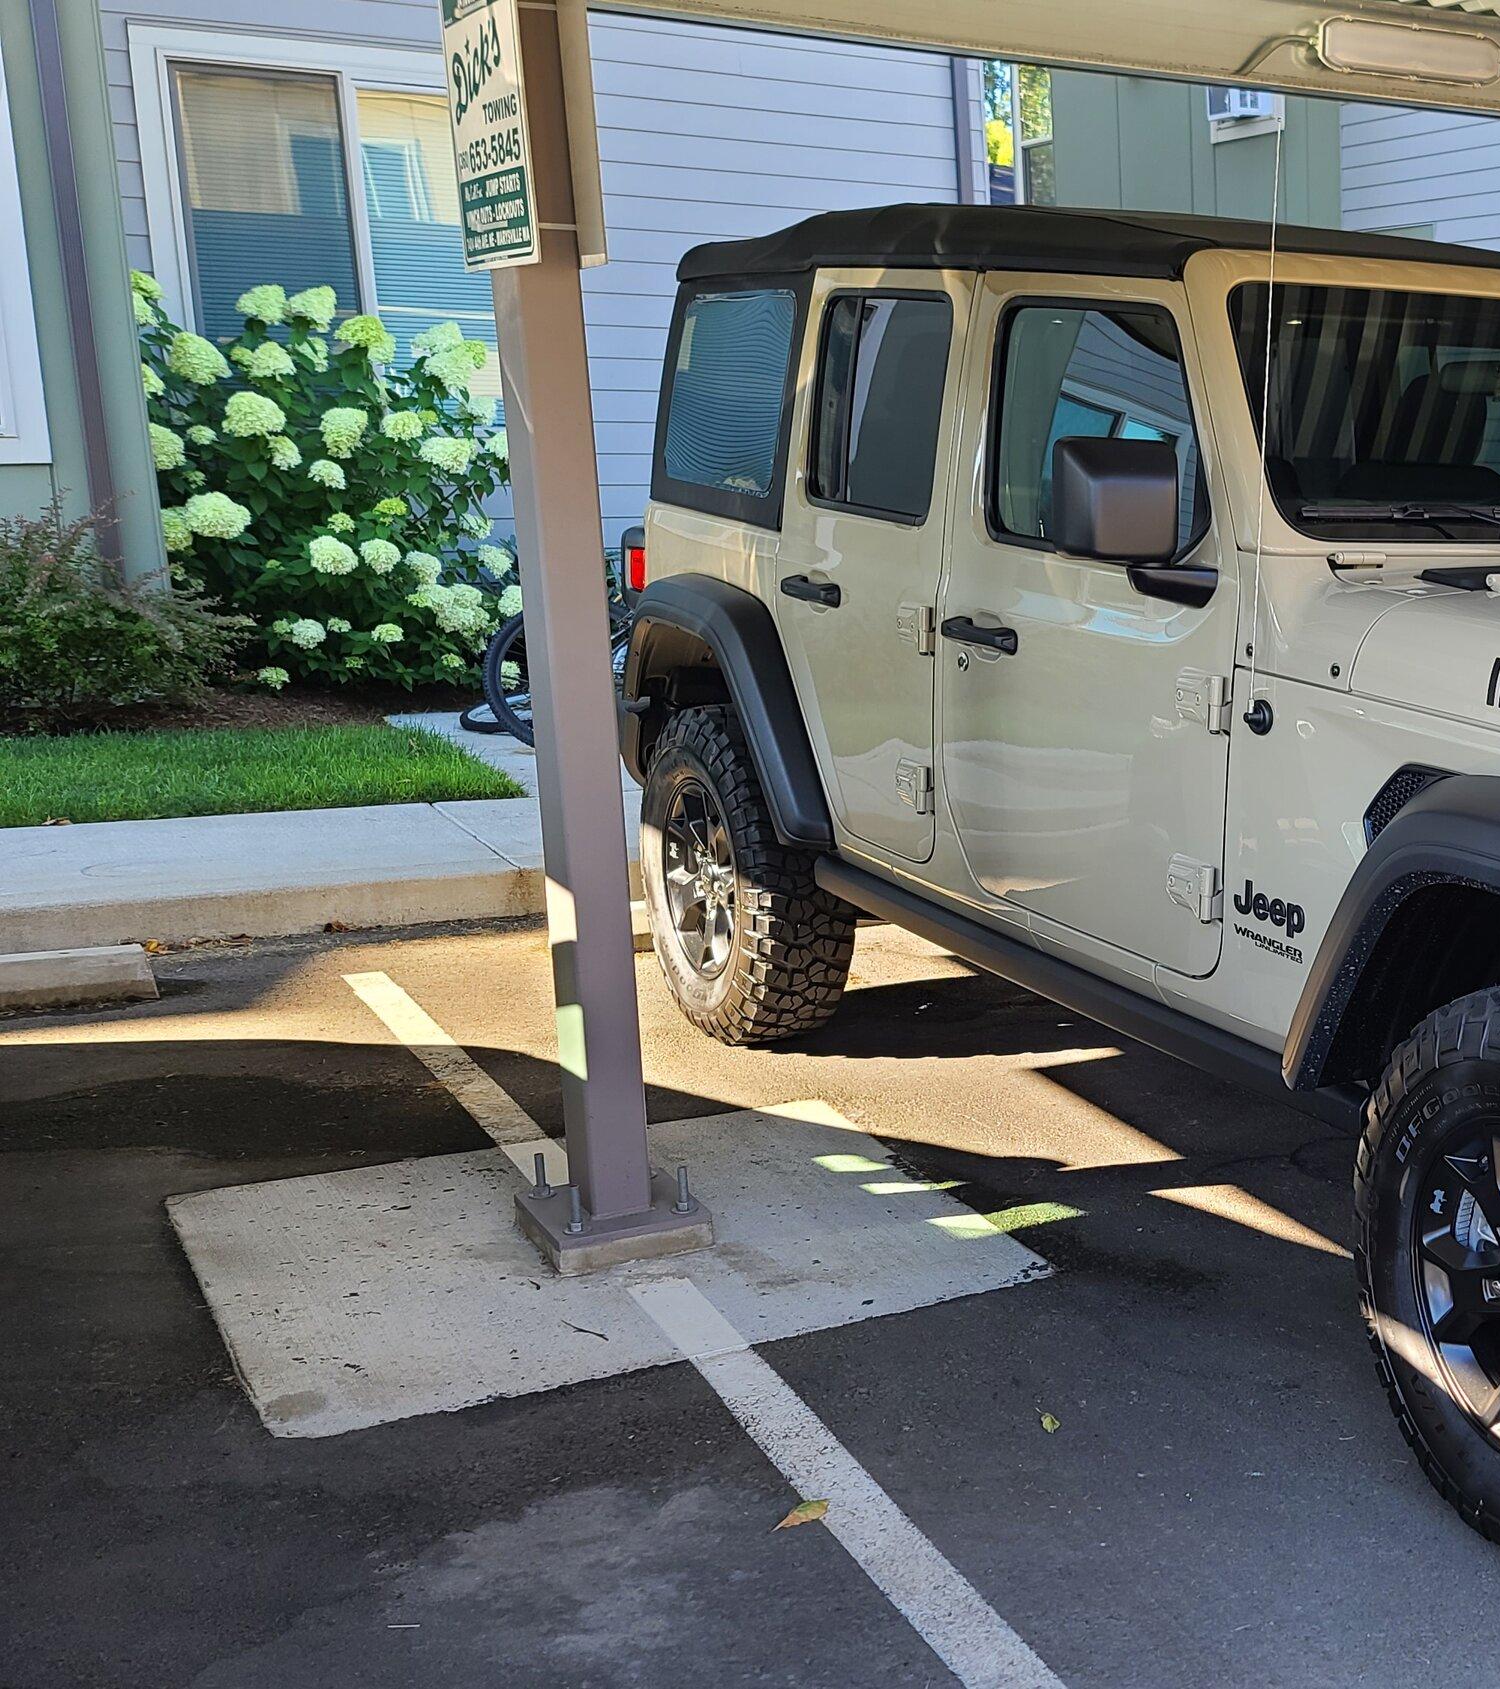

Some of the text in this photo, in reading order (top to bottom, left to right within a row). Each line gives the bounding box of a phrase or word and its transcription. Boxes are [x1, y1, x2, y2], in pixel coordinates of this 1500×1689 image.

[452, 16, 501, 126] Dick's
[482, 93, 517, 124] TOWING
[469, 127, 521, 173] 653-5845
[499, 172, 520, 195] STARTS
[495, 198, 524, 221] LOCKOUTS
[1234, 879, 1305, 938] Jeep
[1233, 923, 1303, 959] WRANGLER
[1254, 941, 1303, 964] UNLIMITED
